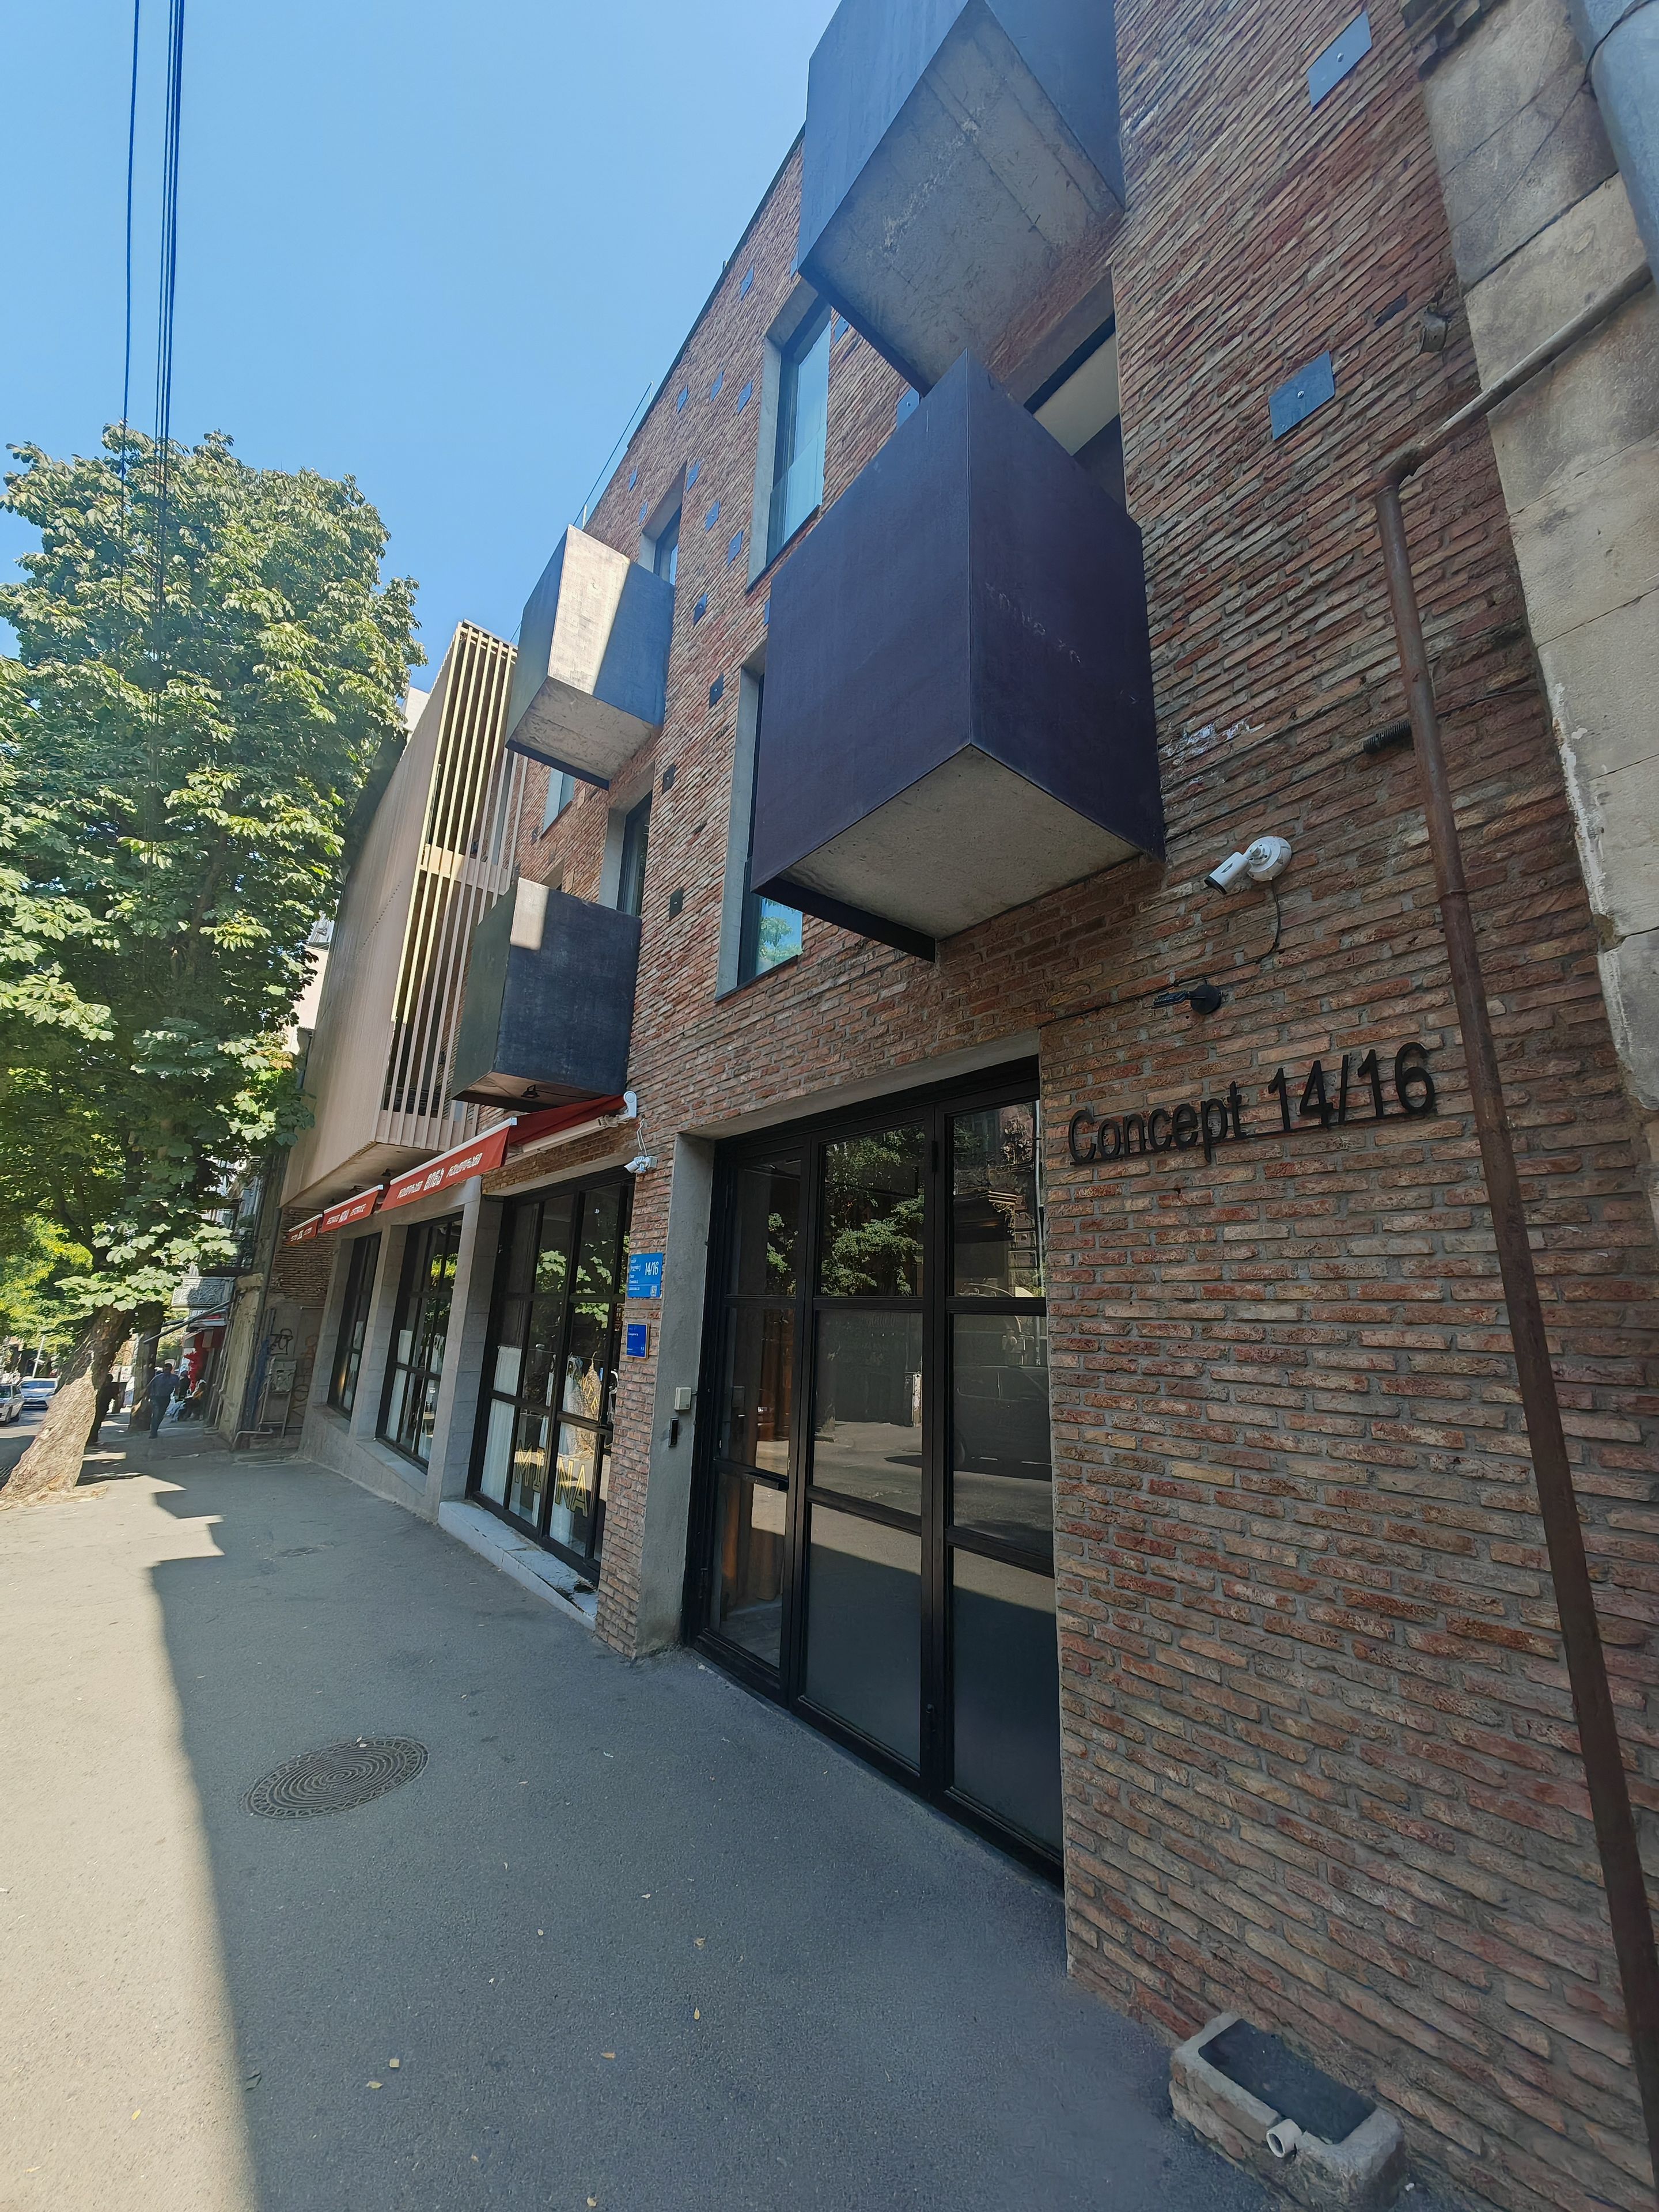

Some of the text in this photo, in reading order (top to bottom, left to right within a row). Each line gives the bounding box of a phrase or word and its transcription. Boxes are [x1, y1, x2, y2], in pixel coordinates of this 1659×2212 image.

[1068, 1041, 1435, 1163] Concept 14/16
[645, 1261, 660, 1276] 14/16
[514, 1440, 588, 1518] MINA
